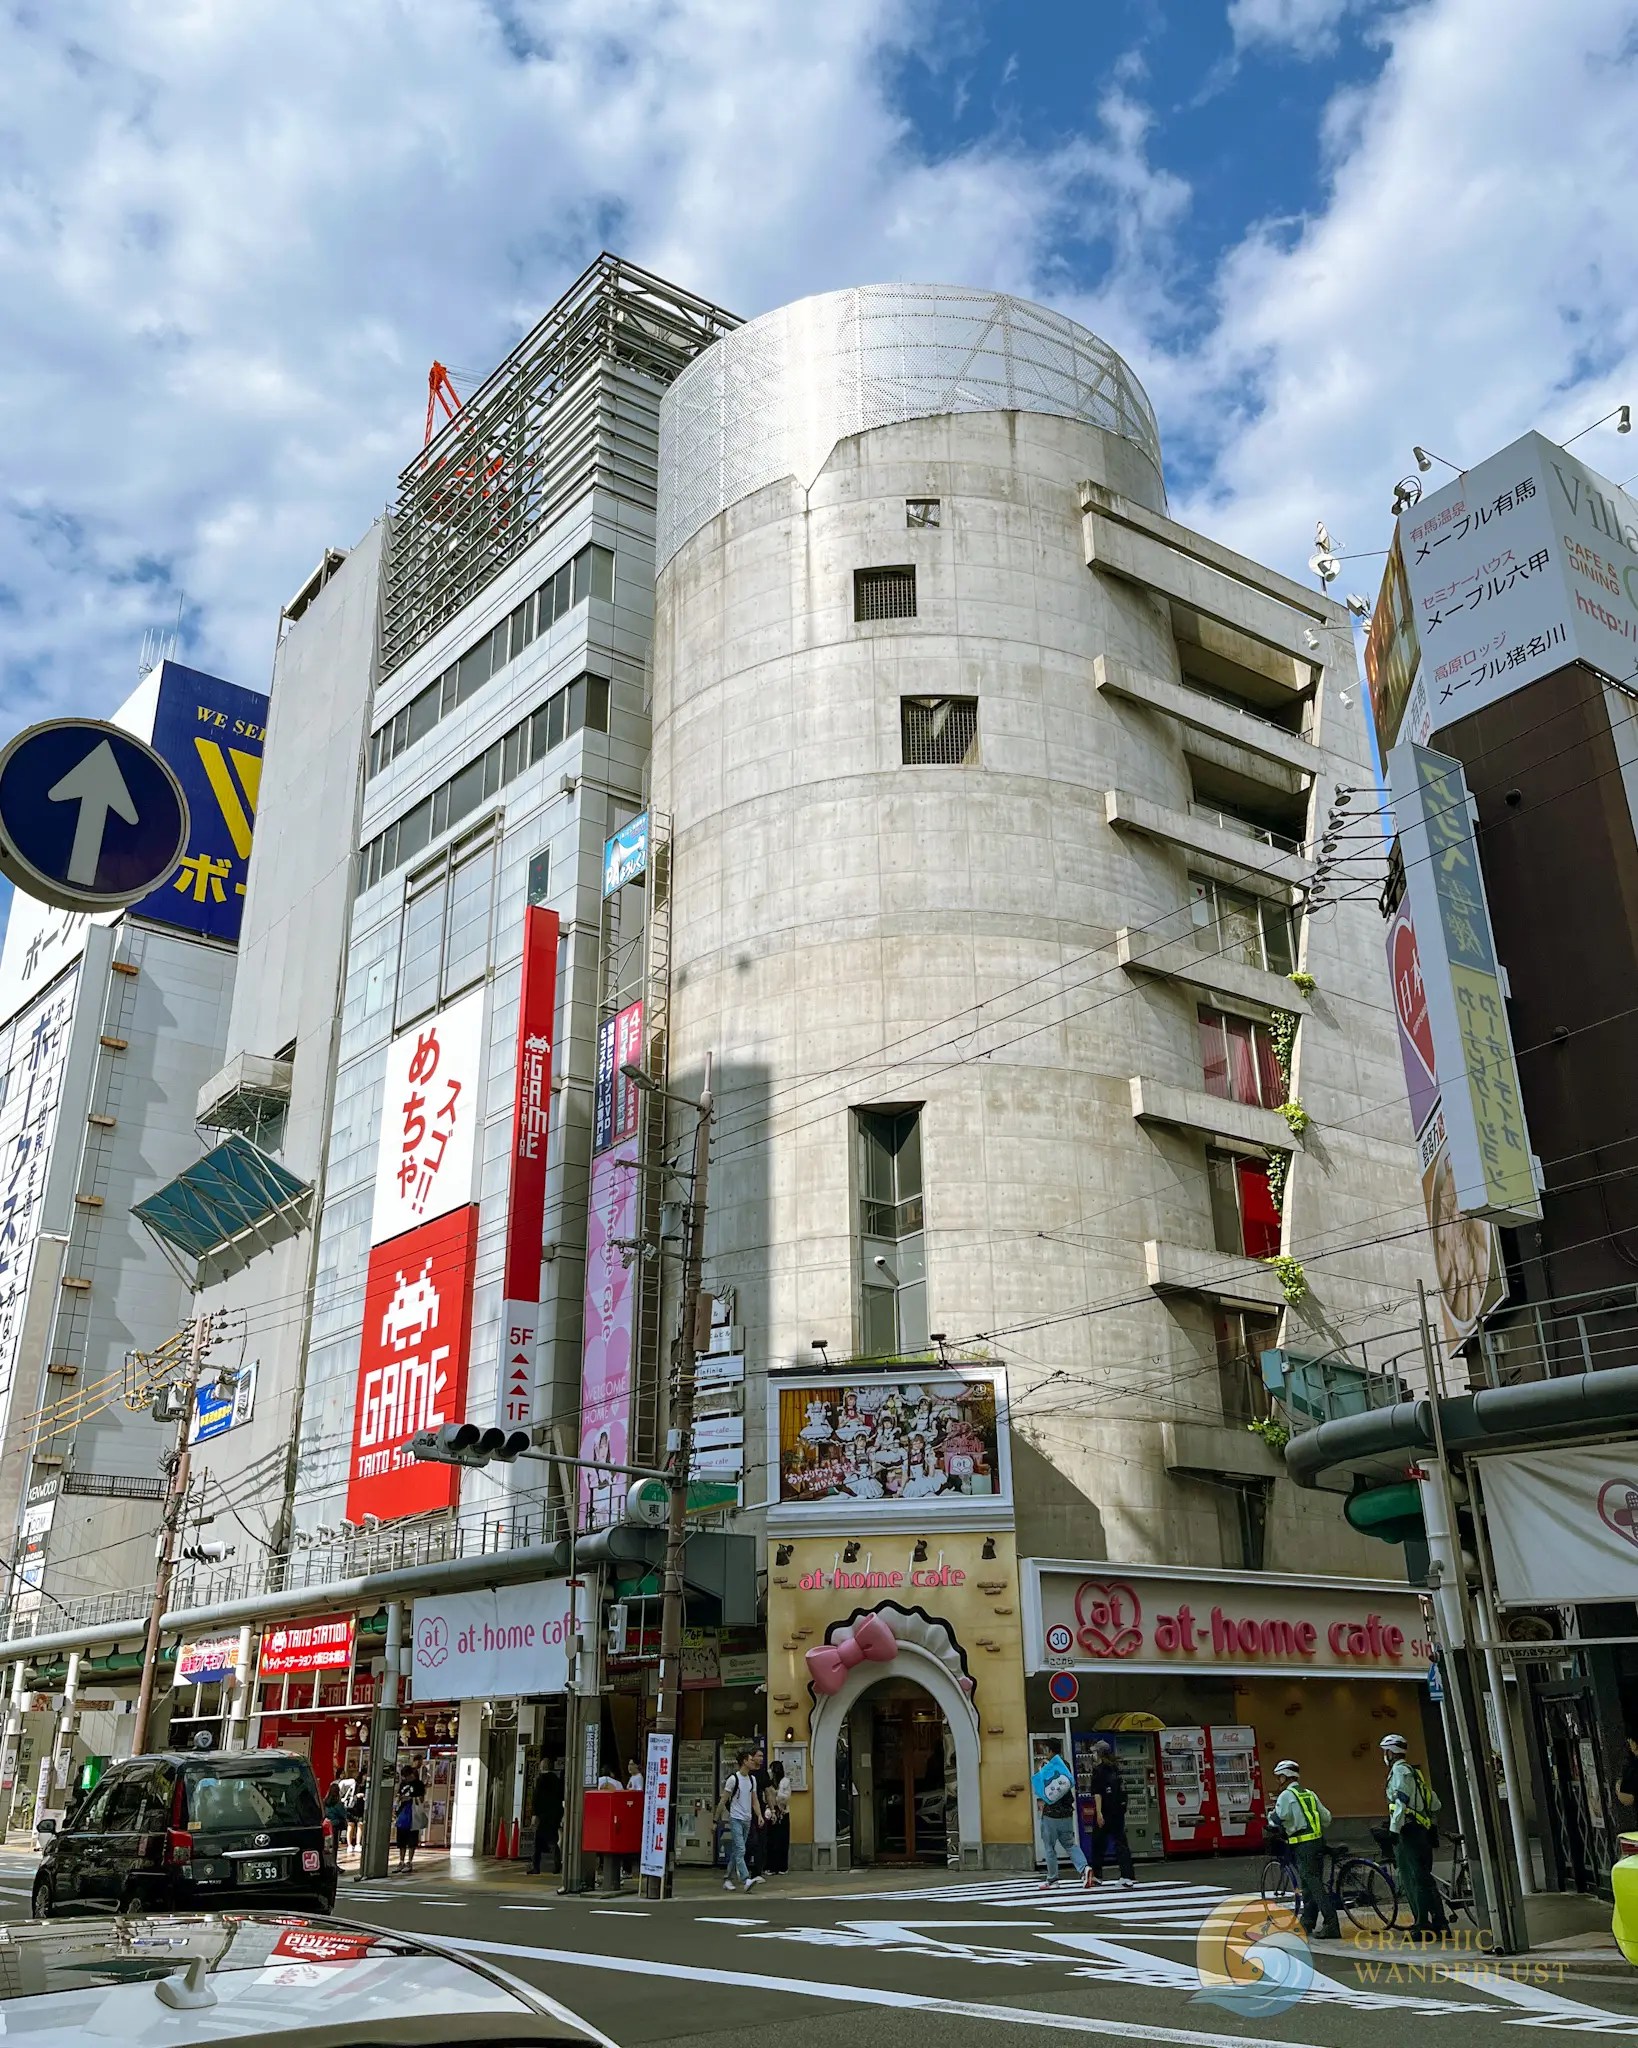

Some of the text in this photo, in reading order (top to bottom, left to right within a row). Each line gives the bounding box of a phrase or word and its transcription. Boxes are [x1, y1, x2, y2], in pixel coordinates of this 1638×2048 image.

[1409, 500, 1467, 542] 有馬温泉
[1415, 477, 1537, 565] メープル有馬
[1564, 535, 1618, 580] CAFE &
[1569, 554, 1620, 596] DINING
[1422, 550, 1516, 611] セミナーハウス
[1427, 549, 1550, 634] メープル六甲
[1433, 631, 1508, 683] 高原ロッジ
[1439, 623, 1566, 704] メープル猪名川
[197, 705, 228, 730] WE
[396, 1027, 441, 1199] めちゃ
[526, 1054, 547, 1160] GAME
[518, 1097, 529, 1157] STATION
[509, 1327, 533, 1346] 5F
[360, 1345, 449, 1449] GAME
[585, 1376, 626, 1401] WELCOME
[506, 1403, 530, 1421] 1F
[584, 1405, 609, 1425] HOME
[358, 1449, 390, 1478] TAITO
[28, 1480, 57, 1500] KENWOOD
[649, 1504, 660, 1518] 東
[911, 1564, 966, 1587] cafe
[1091, 1594, 1127, 1628] at
[288, 1623, 347, 1648] TAITO STATION
[423, 1629, 440, 1647] at
[458, 1611, 581, 1655] at-home cafe
[1052, 1632, 1068, 1646] 30
[1154, 1604, 1317, 1656] at-home
[1328, 1613, 1404, 1658] cafe
[329, 1686, 346, 1705] TAIT
